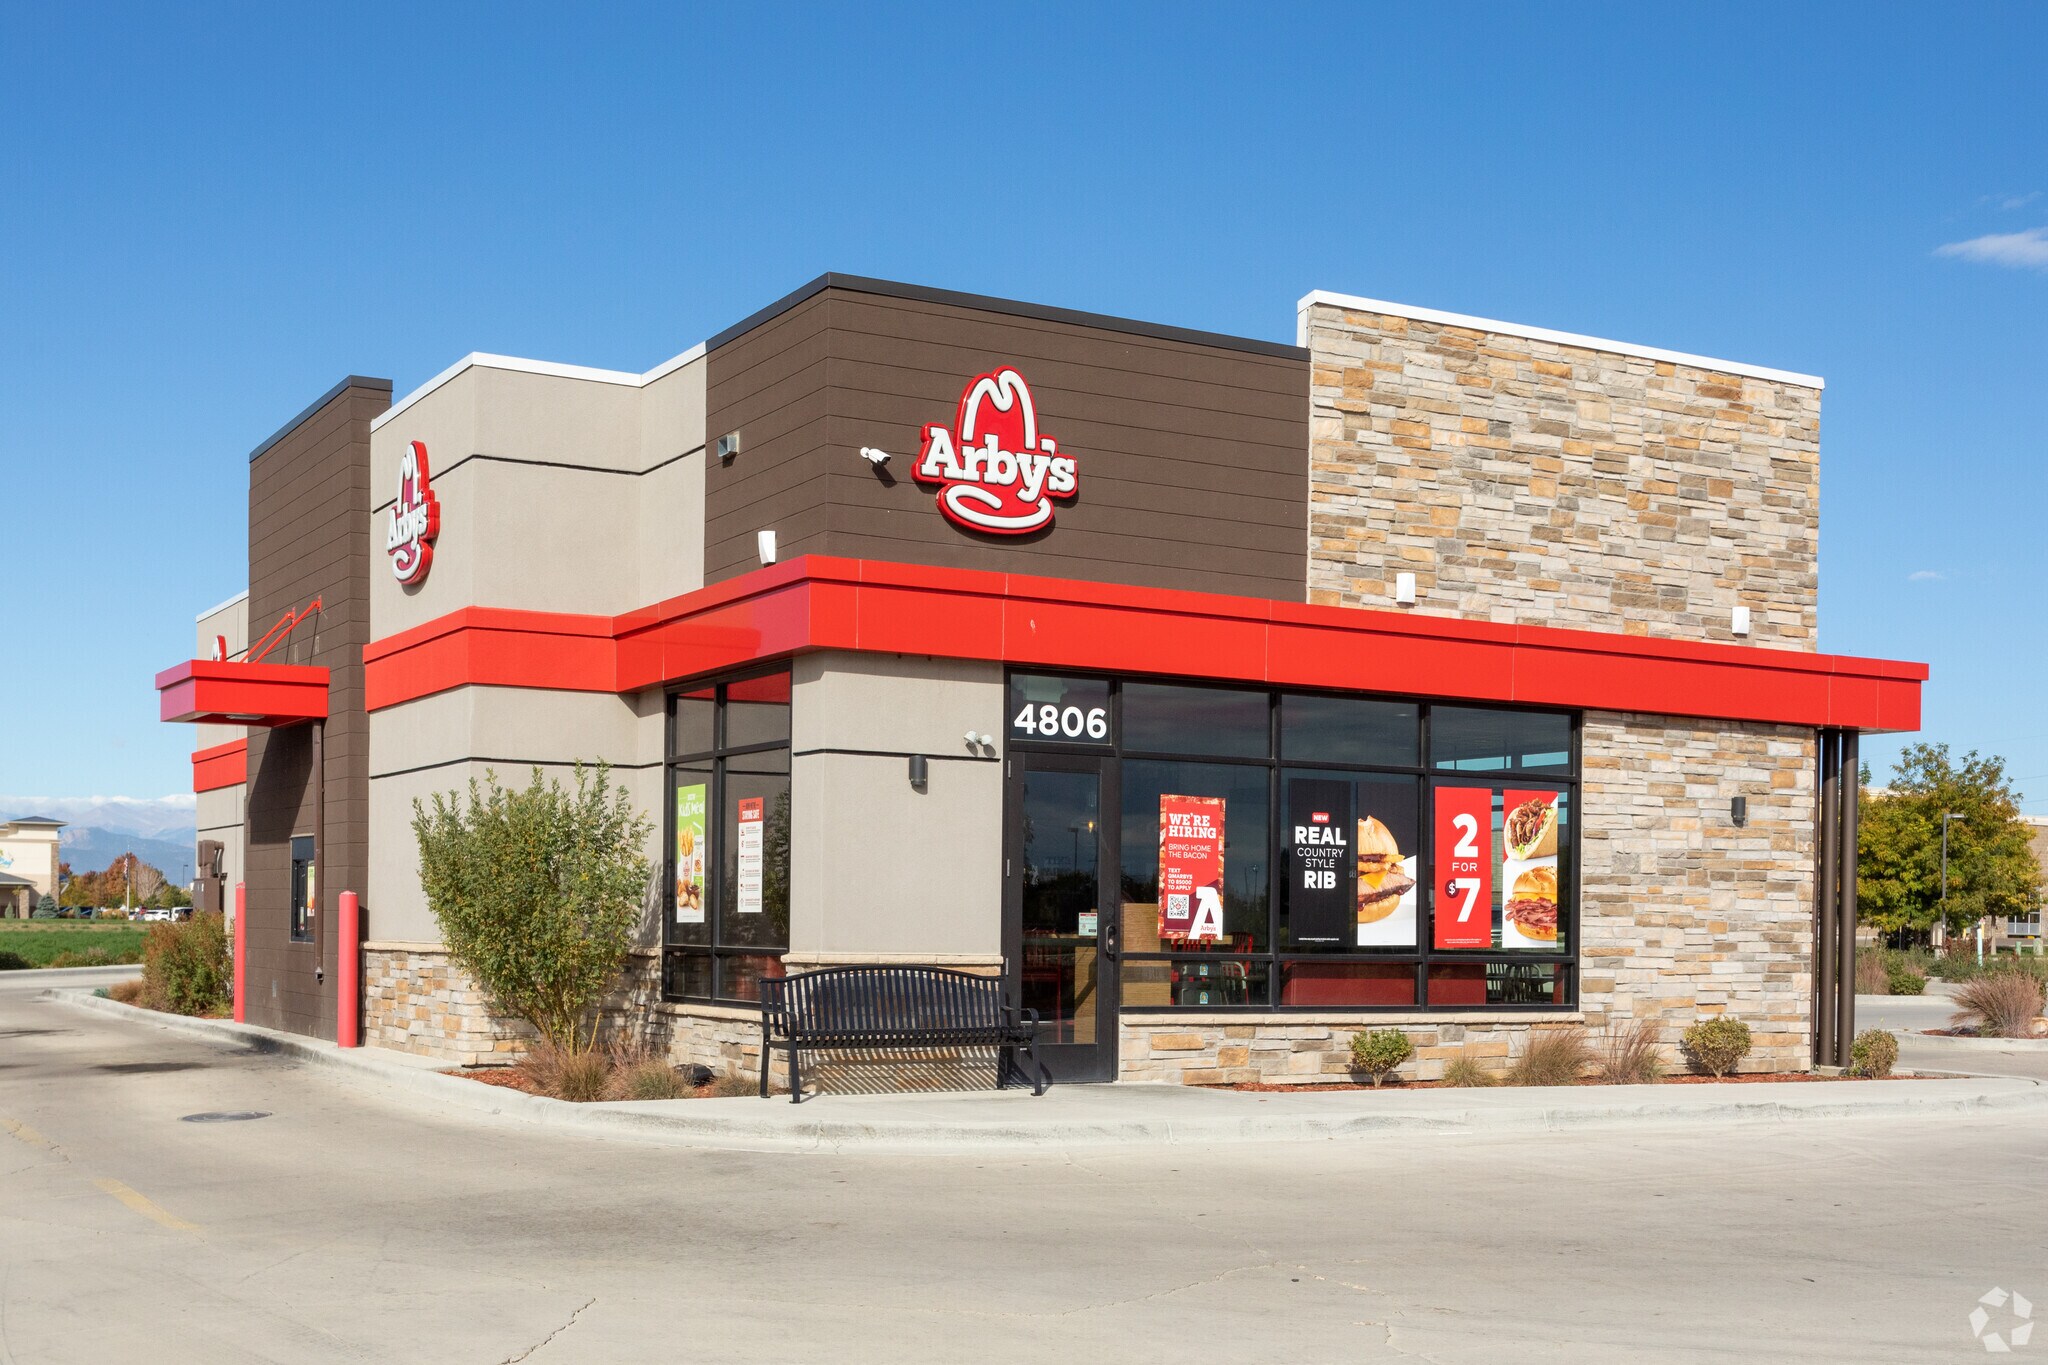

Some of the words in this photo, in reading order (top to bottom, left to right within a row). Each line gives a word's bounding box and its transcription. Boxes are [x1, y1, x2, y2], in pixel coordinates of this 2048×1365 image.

[920, 426, 1075, 502] Arby's
[387, 491, 428, 550] Arby's
[1014, 704, 1107, 739] 4806
[1169, 813, 1210, 827] WE'RE
[1168, 826, 1217, 839] HIRING
[1295, 826, 1347, 845] REAL
[1452, 813, 1479, 857] 2
[1168, 843, 1189, 851] BRING
[1191, 844, 1211, 852] HOME
[1297, 848, 1344, 857] COUNTRY
[1305, 858, 1335, 868] STYLE
[1452, 862, 1478, 872] FOR
[1304, 870, 1336, 889] RIB
